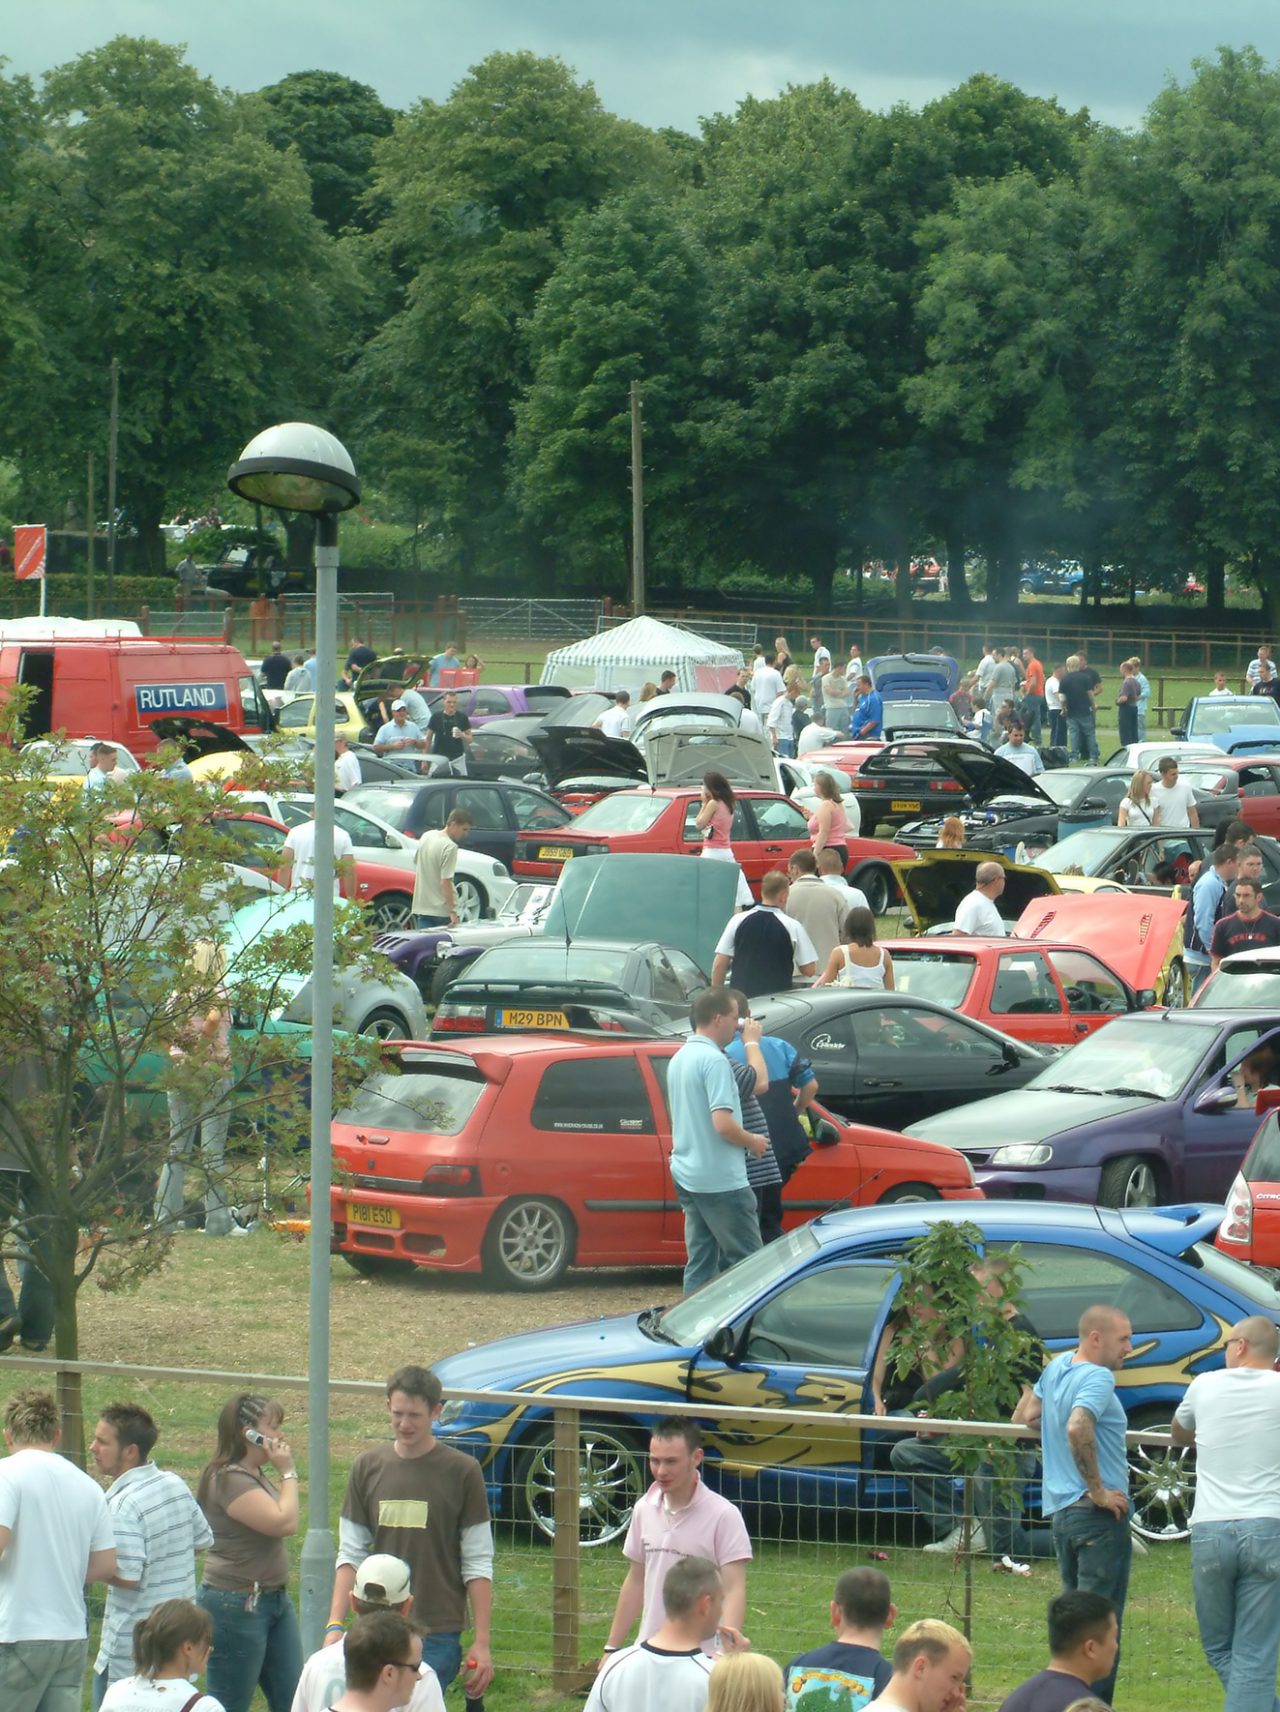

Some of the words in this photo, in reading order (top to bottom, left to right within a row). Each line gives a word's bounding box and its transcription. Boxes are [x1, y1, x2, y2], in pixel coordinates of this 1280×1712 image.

[140, 687, 216, 709] RUTLAND
[509, 1012, 533, 1025] M29
[536, 1013, 562, 1026] BPN
